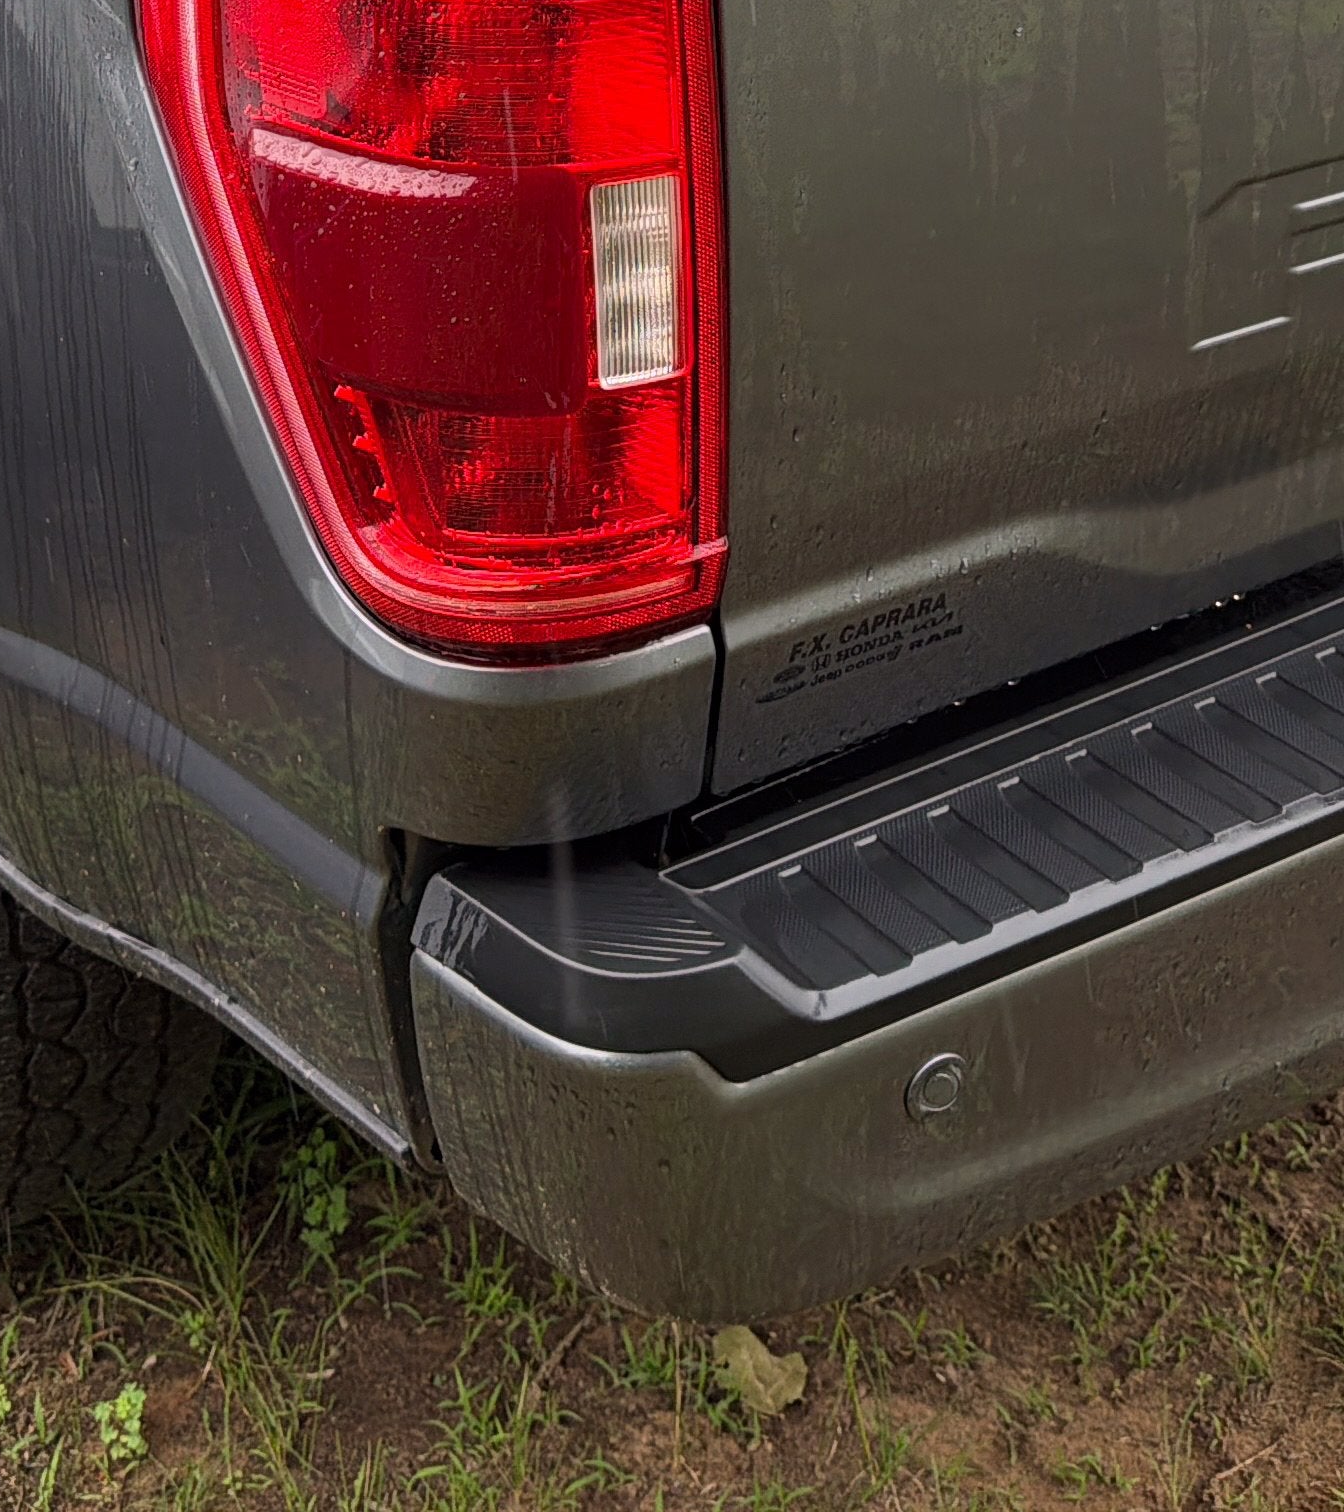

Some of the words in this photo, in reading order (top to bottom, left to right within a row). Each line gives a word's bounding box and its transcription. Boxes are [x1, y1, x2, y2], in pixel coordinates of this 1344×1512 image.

[787, 632, 831, 664] F.X.
[839, 592, 948, 645] CAPRARA
[835, 630, 905, 664] HONDA
[810, 668, 843, 687] Jeep
